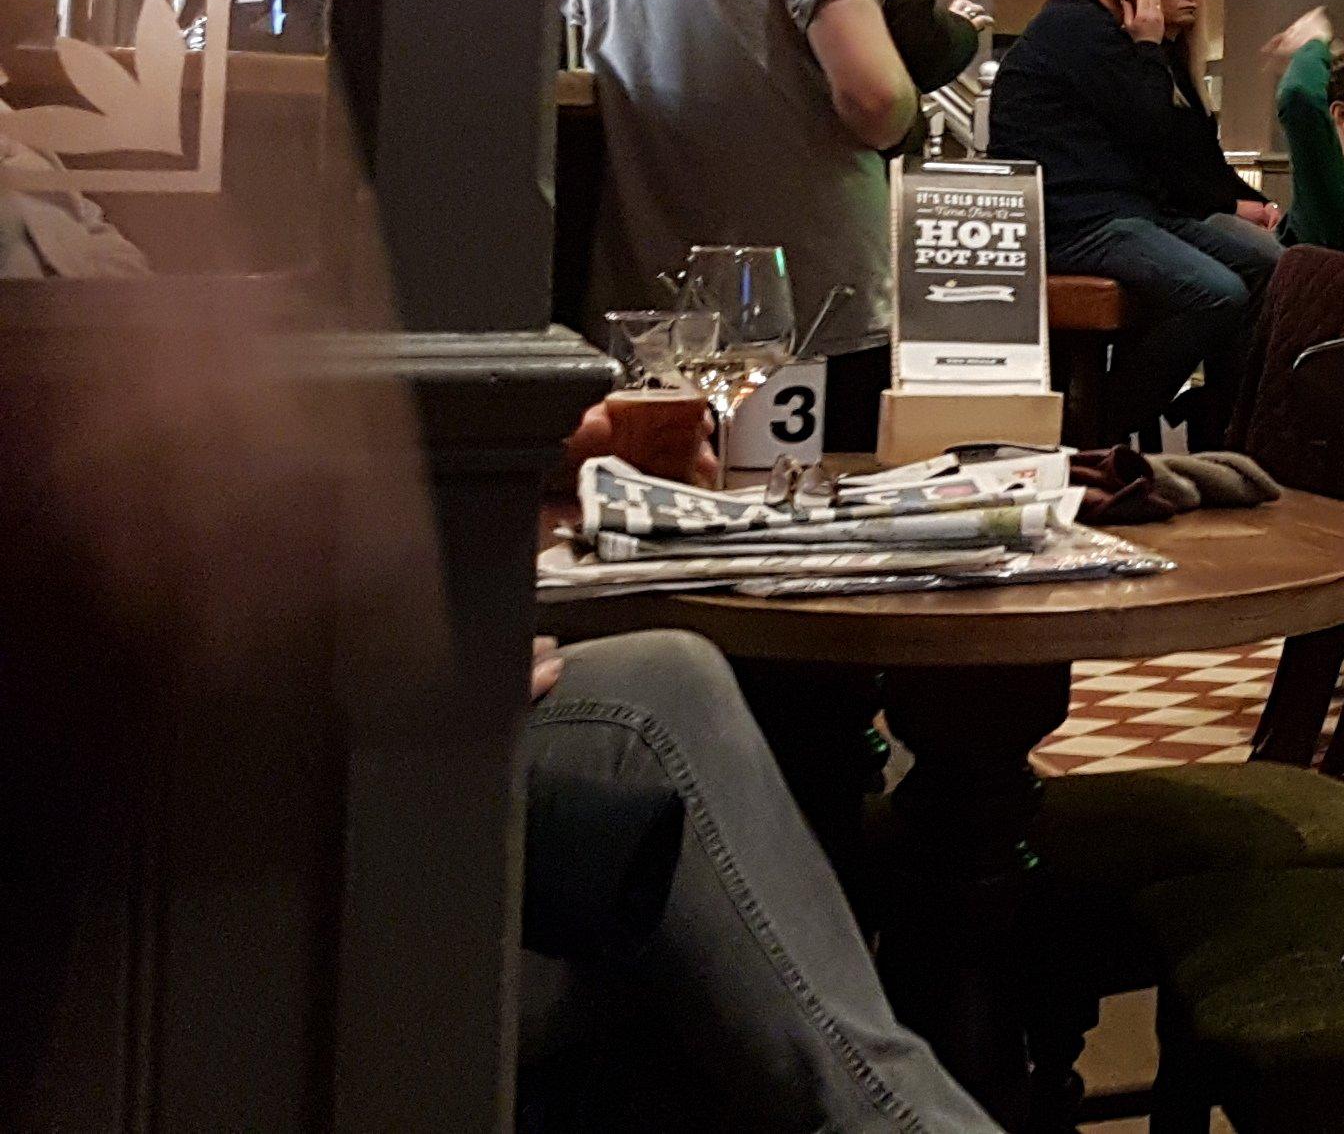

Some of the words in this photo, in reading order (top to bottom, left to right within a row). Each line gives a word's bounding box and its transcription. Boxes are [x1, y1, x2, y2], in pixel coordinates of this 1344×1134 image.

[915, 219, 1027, 249] HOT
[915, 248, 972, 265] POT
[975, 250, 1027, 267] PIE
[770, 385, 816, 443] 3
